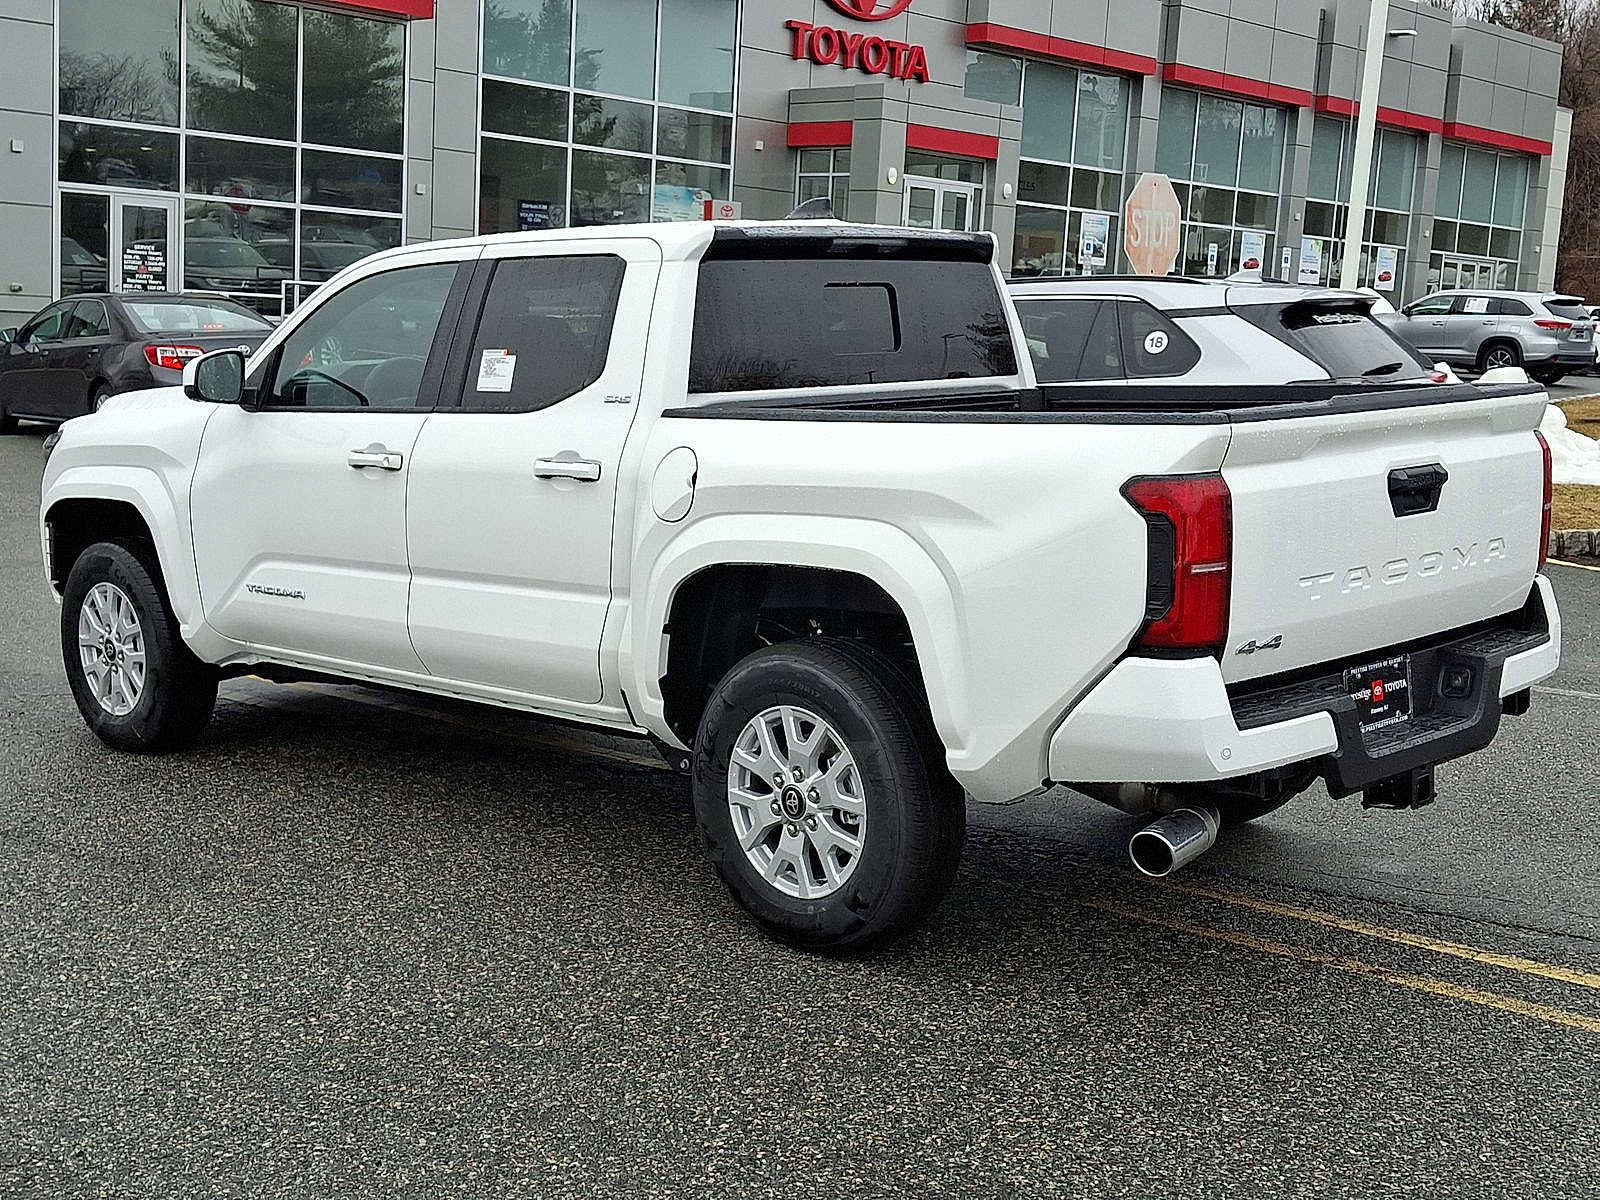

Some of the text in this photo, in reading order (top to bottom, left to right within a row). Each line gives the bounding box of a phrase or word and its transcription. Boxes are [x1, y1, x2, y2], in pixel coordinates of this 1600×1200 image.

[785, 19, 930, 83] TOYOTA
[1131, 208, 1176, 248] STOP
[1149, 336, 1164, 348] 18
[1299, 537, 1507, 600] TACOMA
[245, 583, 307, 600] TACOMA
[1384, 679, 1407, 693] TOYOTA
